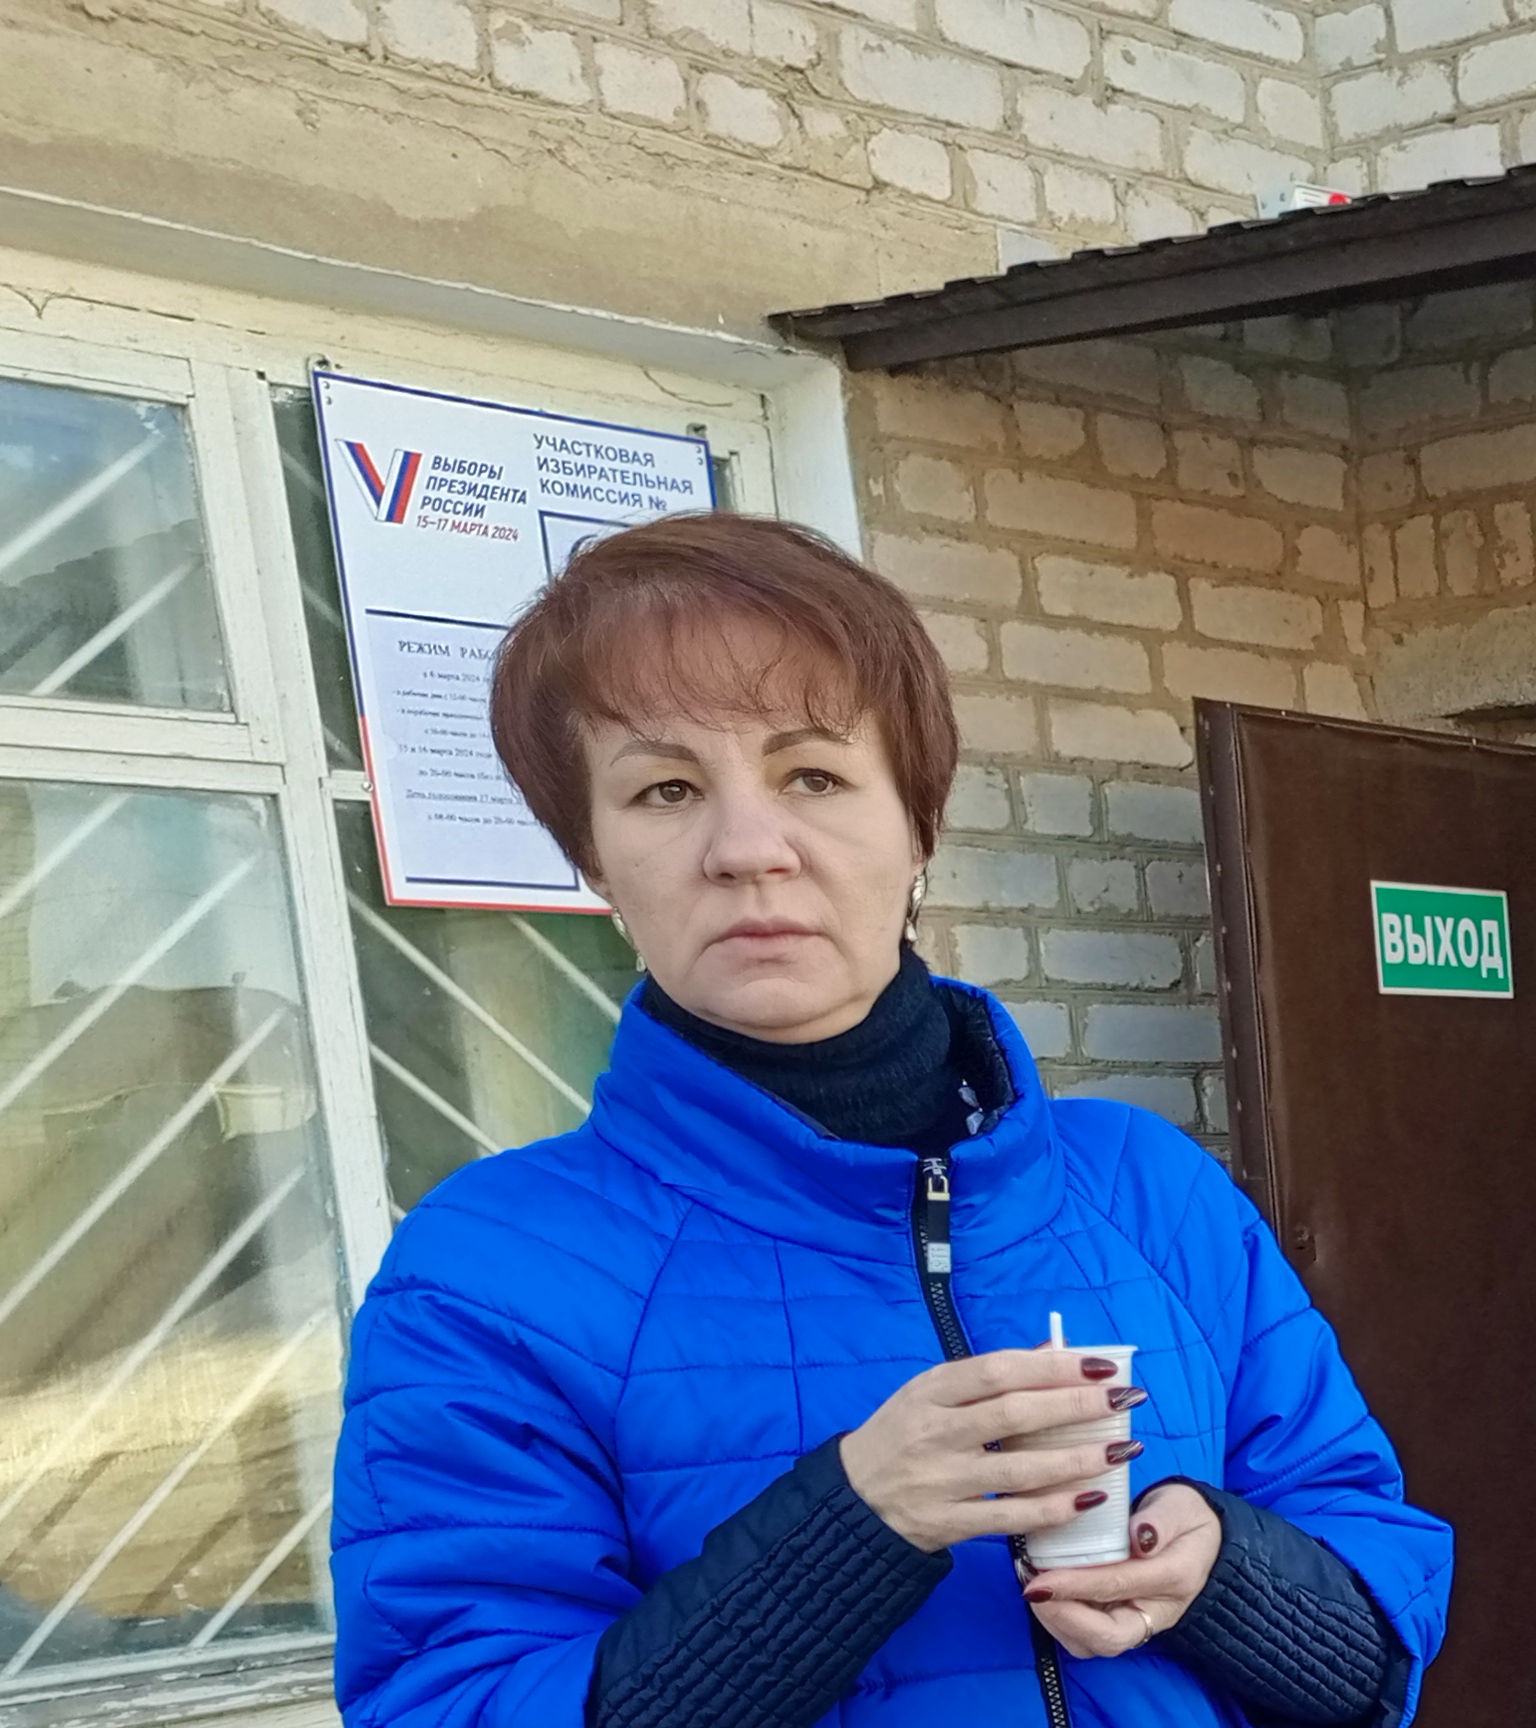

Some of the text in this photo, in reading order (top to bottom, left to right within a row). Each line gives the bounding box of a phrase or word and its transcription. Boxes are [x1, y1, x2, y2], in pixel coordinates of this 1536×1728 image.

[533, 433, 655, 467] УЧАСТКОВАЯ
[431, 456, 503, 480] ВЫБОРЫ
[536, 456, 694, 495] ИЗБИРАТЕЛЬНАЯ
[425, 476, 527, 504] ПРЕЗИДЕНТА
[539, 478, 668, 511] КОМИССИЯ №
[420, 496, 486, 518] РОССИИ
[450, 519, 489, 536] МАРТА
[491, 526, 519, 541] 2024
[398, 640, 451, 657] РЕЖИМ
[1381, 913, 1504, 979] ВЫХОД
